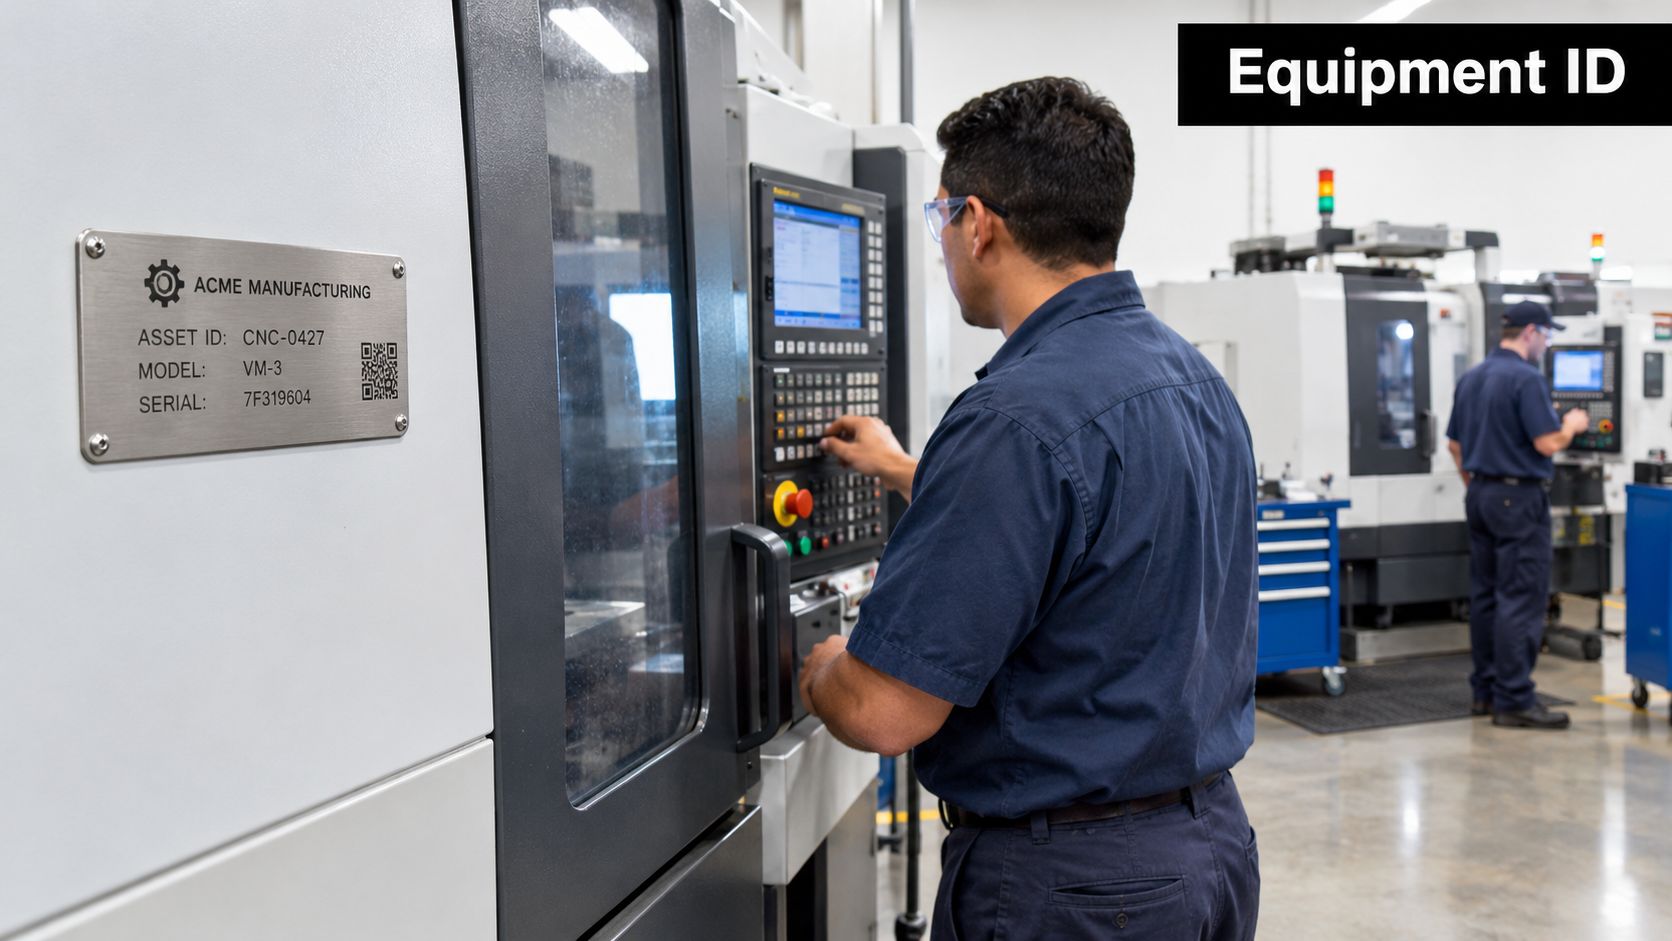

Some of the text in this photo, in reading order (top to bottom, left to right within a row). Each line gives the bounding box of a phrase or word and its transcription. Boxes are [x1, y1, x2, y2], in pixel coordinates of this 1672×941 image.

[194, 277, 370, 299] ACME MANUFACTURING
[138, 329, 324, 346] ASSET ID: CNC-0427
[139, 360, 281, 379] MODEL: VM-3
[140, 390, 311, 413] SERIAL: 7F319604
